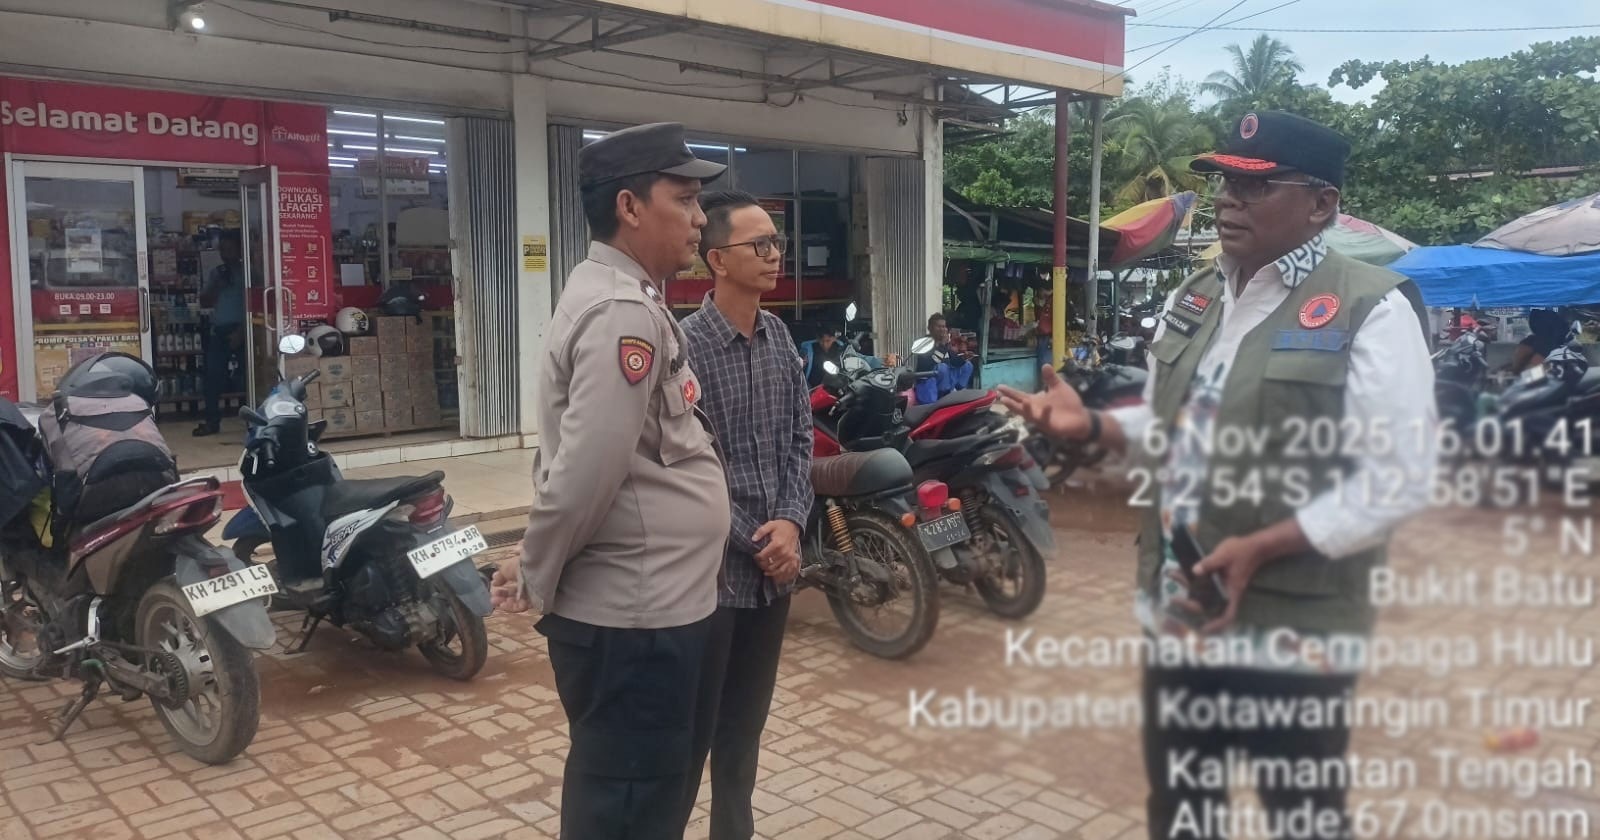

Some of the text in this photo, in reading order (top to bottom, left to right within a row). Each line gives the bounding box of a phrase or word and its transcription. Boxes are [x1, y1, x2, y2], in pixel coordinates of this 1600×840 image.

[0, 101, 258, 146] Selamat Datang
[278, 193, 322, 203] PLIKASI
[278, 203, 324, 213] LFAGIFT
[411, 527, 479, 564] KH 6794 BR
[186, 566, 269, 600] KH 2291 LS
